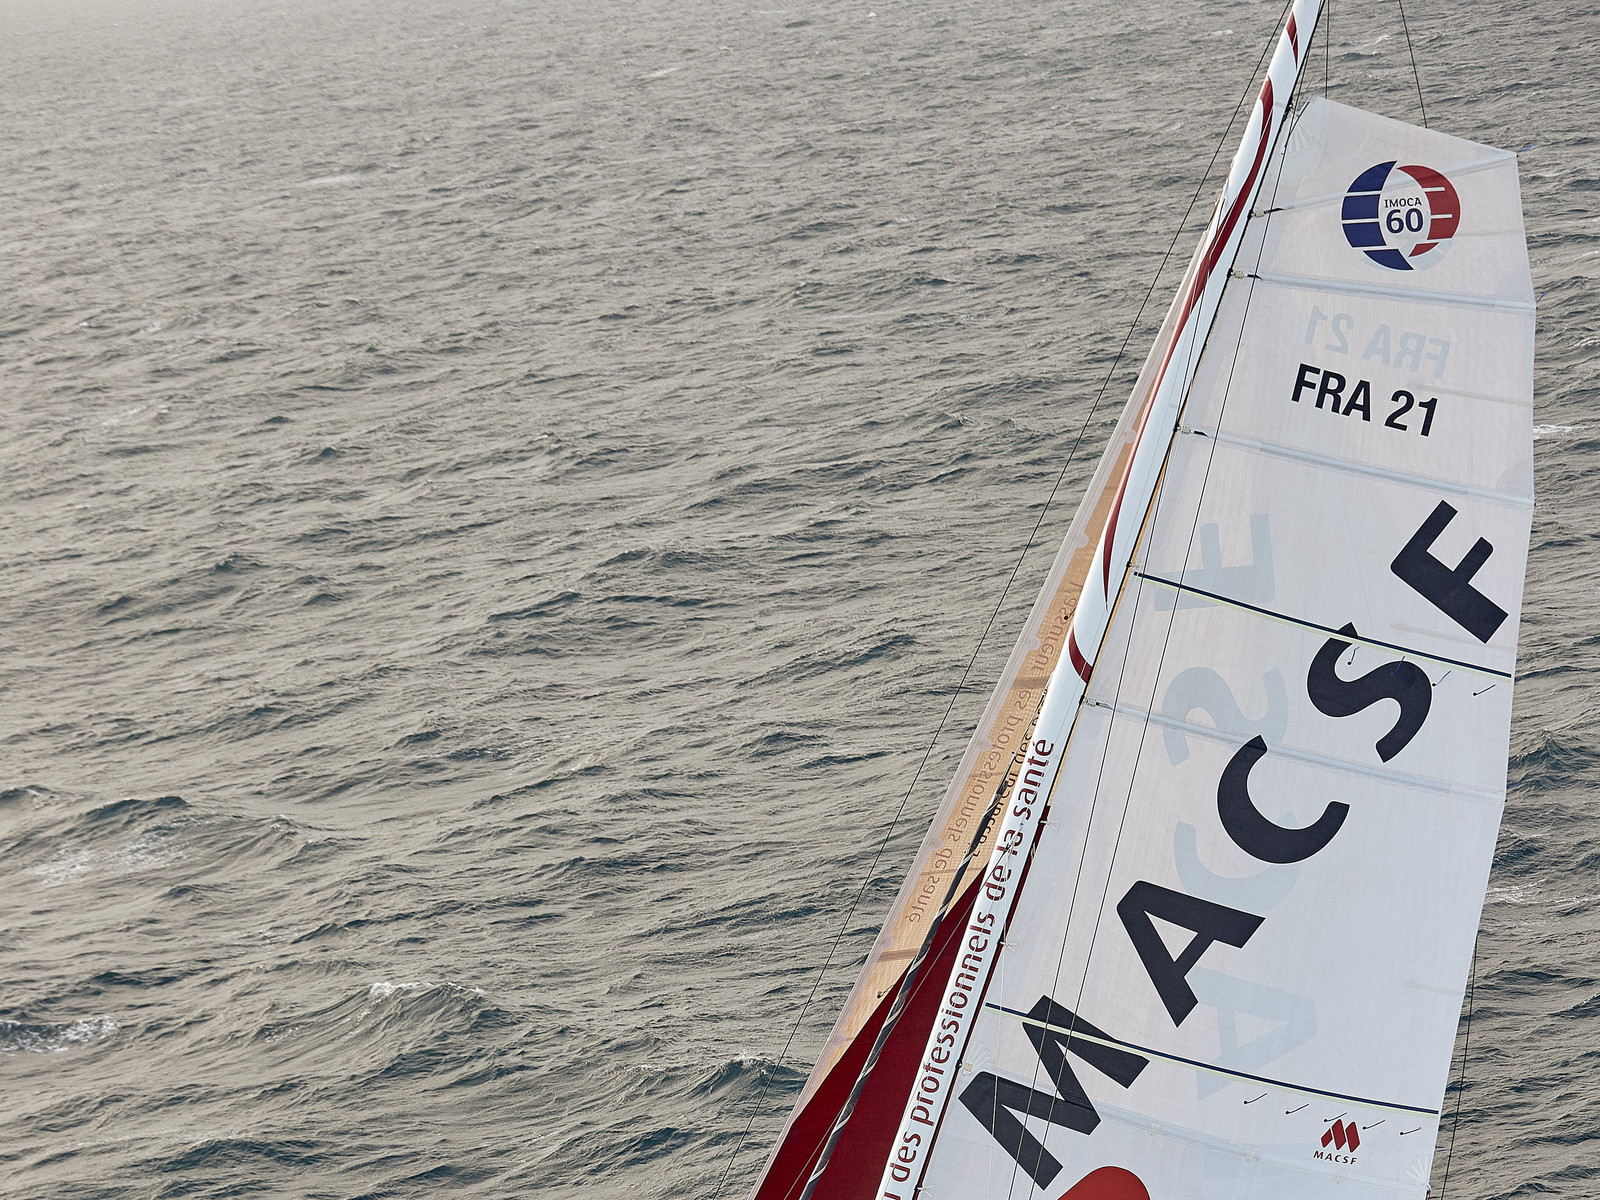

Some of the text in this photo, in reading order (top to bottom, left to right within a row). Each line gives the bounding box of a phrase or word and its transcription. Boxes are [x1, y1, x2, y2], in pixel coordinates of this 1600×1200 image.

[1384, 197, 1422, 208] IMOCA
[1386, 208, 1424, 234] 60
[1291, 362, 1438, 437] FRA 21
[1012, 738, 1055, 820] santé
[957, 499, 1509, 1191] MACSF
[995, 826, 1024, 856] la
[985, 865, 1012, 901] de
[911, 911, 996, 1127] professionnels
[889, 1131, 922, 1183] des
[1313, 1150, 1358, 1165] MACSF
